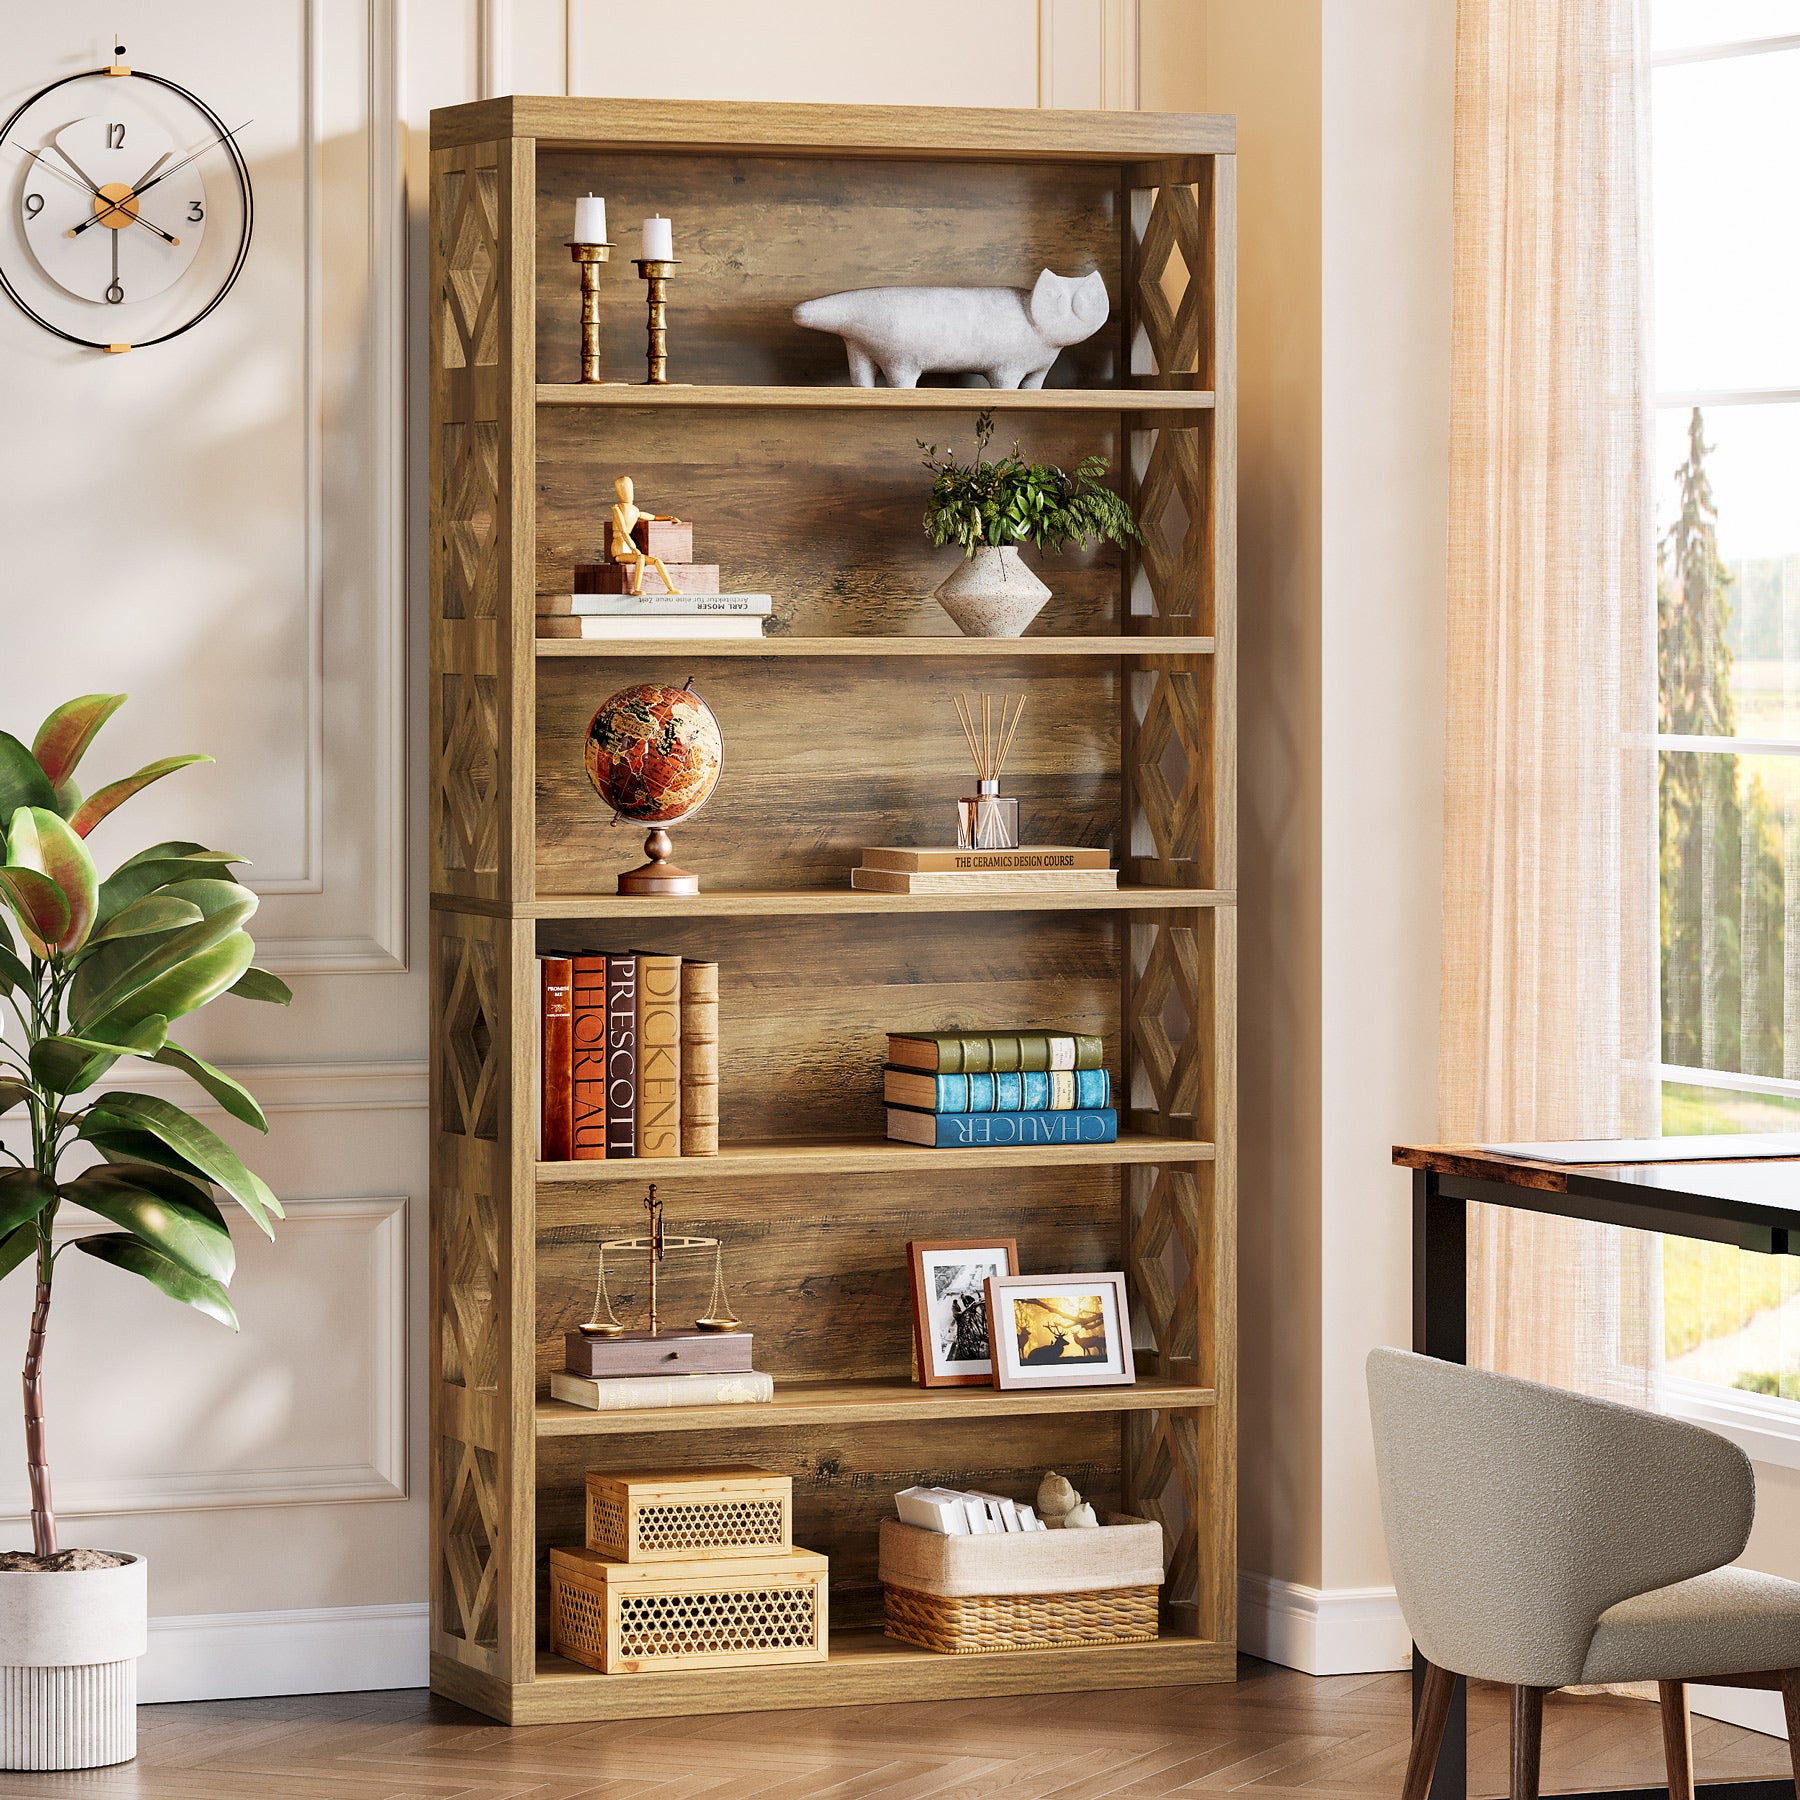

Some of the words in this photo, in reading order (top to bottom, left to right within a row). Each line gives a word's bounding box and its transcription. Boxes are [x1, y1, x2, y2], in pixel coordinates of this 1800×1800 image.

[106, 123, 126, 150] 12
[25, 193, 45, 220] 9
[187, 201, 204, 222] 3
[105, 278, 125, 304] 6
[955, 857, 972, 868] THE
[972, 856, 1013, 867] CERAMICS
[1013, 855, 1043, 867] DESIGN
[1043, 855, 1074, 866] COURSE
[574, 959, 605, 1149] THOREAU
[609, 959, 635, 1156] PRESCOTT
[643, 965, 678, 1150] DICKENS
[951, 1115, 1106, 1143] CHAUCER
